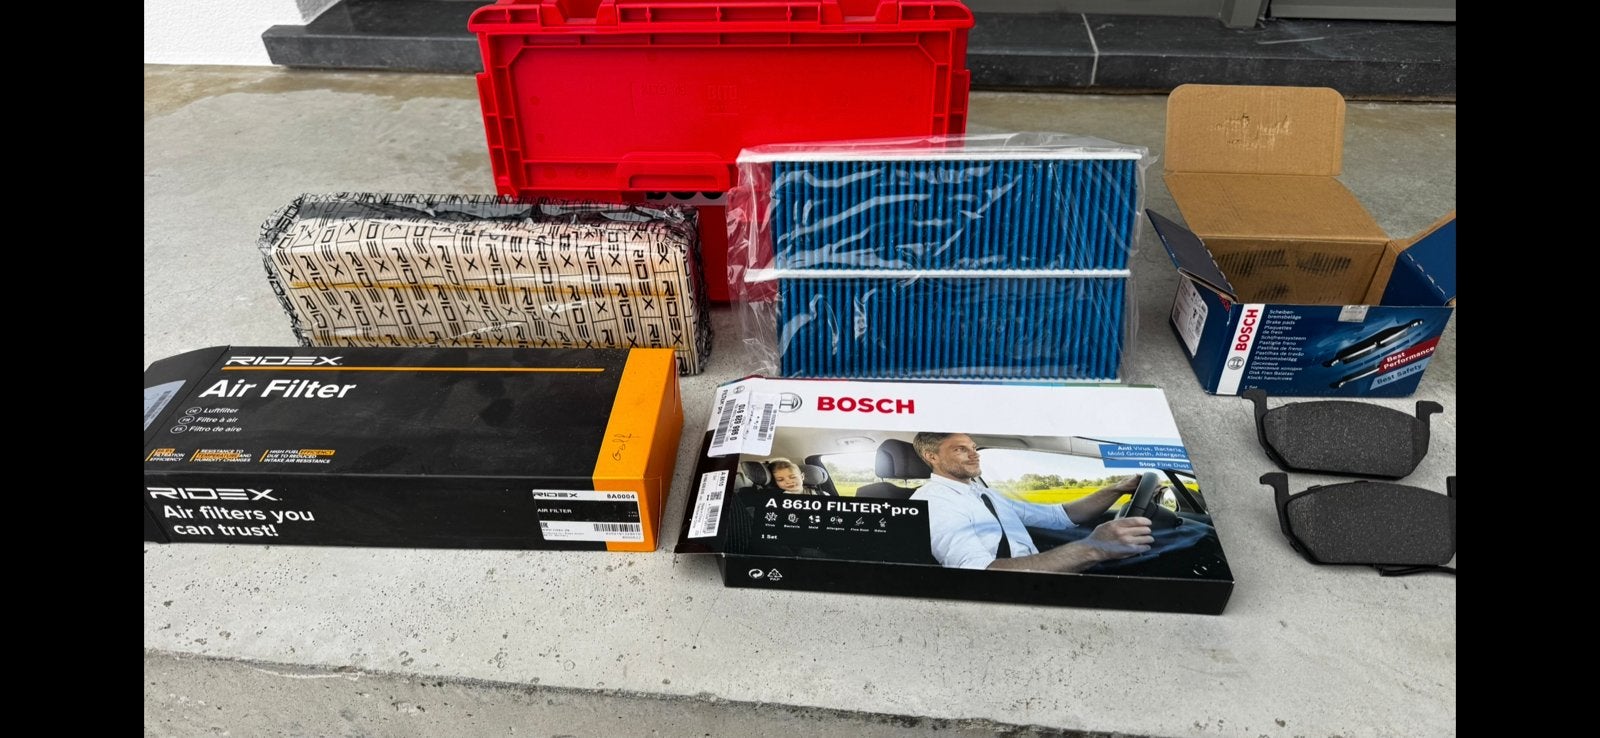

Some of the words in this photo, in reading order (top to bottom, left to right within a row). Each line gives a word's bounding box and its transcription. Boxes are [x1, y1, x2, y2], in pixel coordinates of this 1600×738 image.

[1235, 309, 1258, 351] BOSCH
[225, 356, 343, 366] RIDEX
[1383, 347, 1435, 370] Performance
[1387, 352, 1405, 362] Best
[1377, 375, 1395, 384] Best
[1397, 365, 1422, 377] Safety
[198, 379, 257, 398] Air
[260, 379, 356, 398] Filter
[818, 396, 915, 414] BOSCH
[147, 487, 279, 501] RIDEX
[766, 498, 777, 508] A
[782, 500, 821, 510] 8610
[164, 505, 194, 519] Air
[198, 506, 266, 520] filters
[270, 509, 315, 524] you
[174, 525, 213, 535] can
[217, 524, 279, 537] trust!
